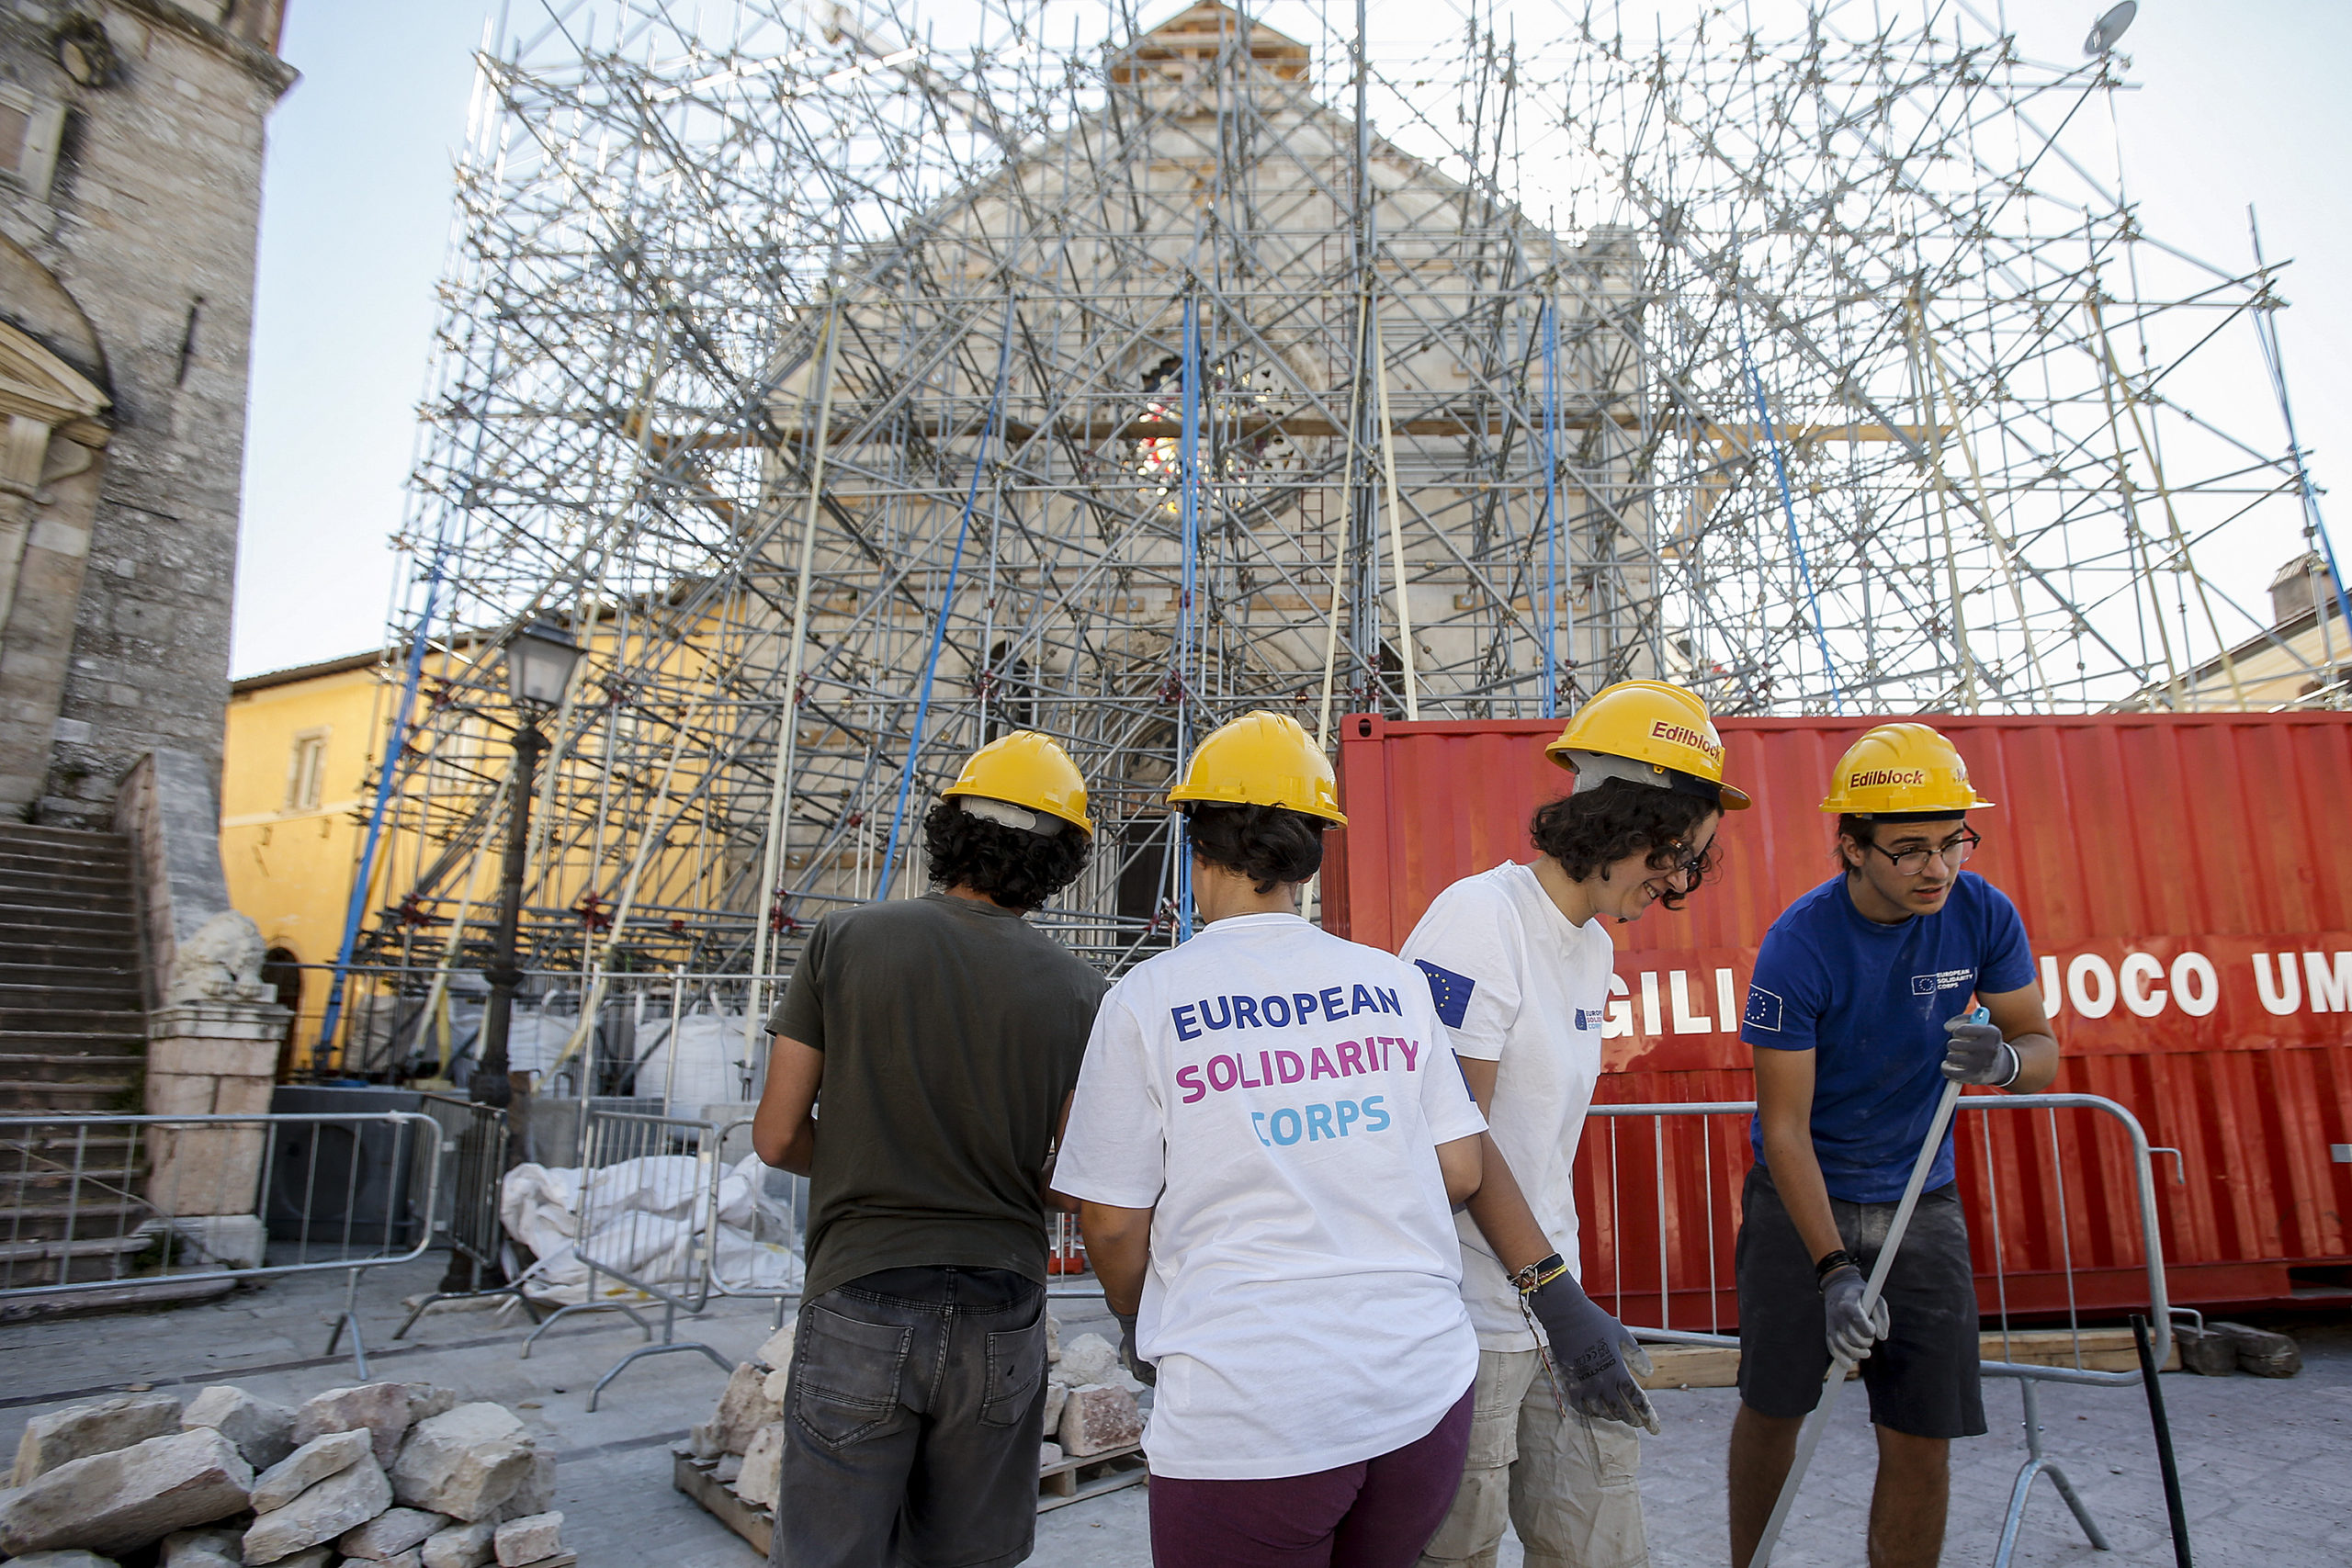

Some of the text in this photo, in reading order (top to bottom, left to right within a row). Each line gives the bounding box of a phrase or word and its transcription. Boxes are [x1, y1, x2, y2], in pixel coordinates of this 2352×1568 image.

[1652, 721, 1721, 761] Edilblock
[1850, 769, 1925, 788] Edilblock
[1936, 968, 1971, 979] EUROPEAN
[1936, 974, 1974, 985] SOLIDARITY
[1937, 982, 1960, 990] CORPS
[2251, 951, 2352, 1016] UM
[1170, 983, 1404, 1043] EUROPEAN
[1175, 1035, 1419, 1104] SOLIDARITY
